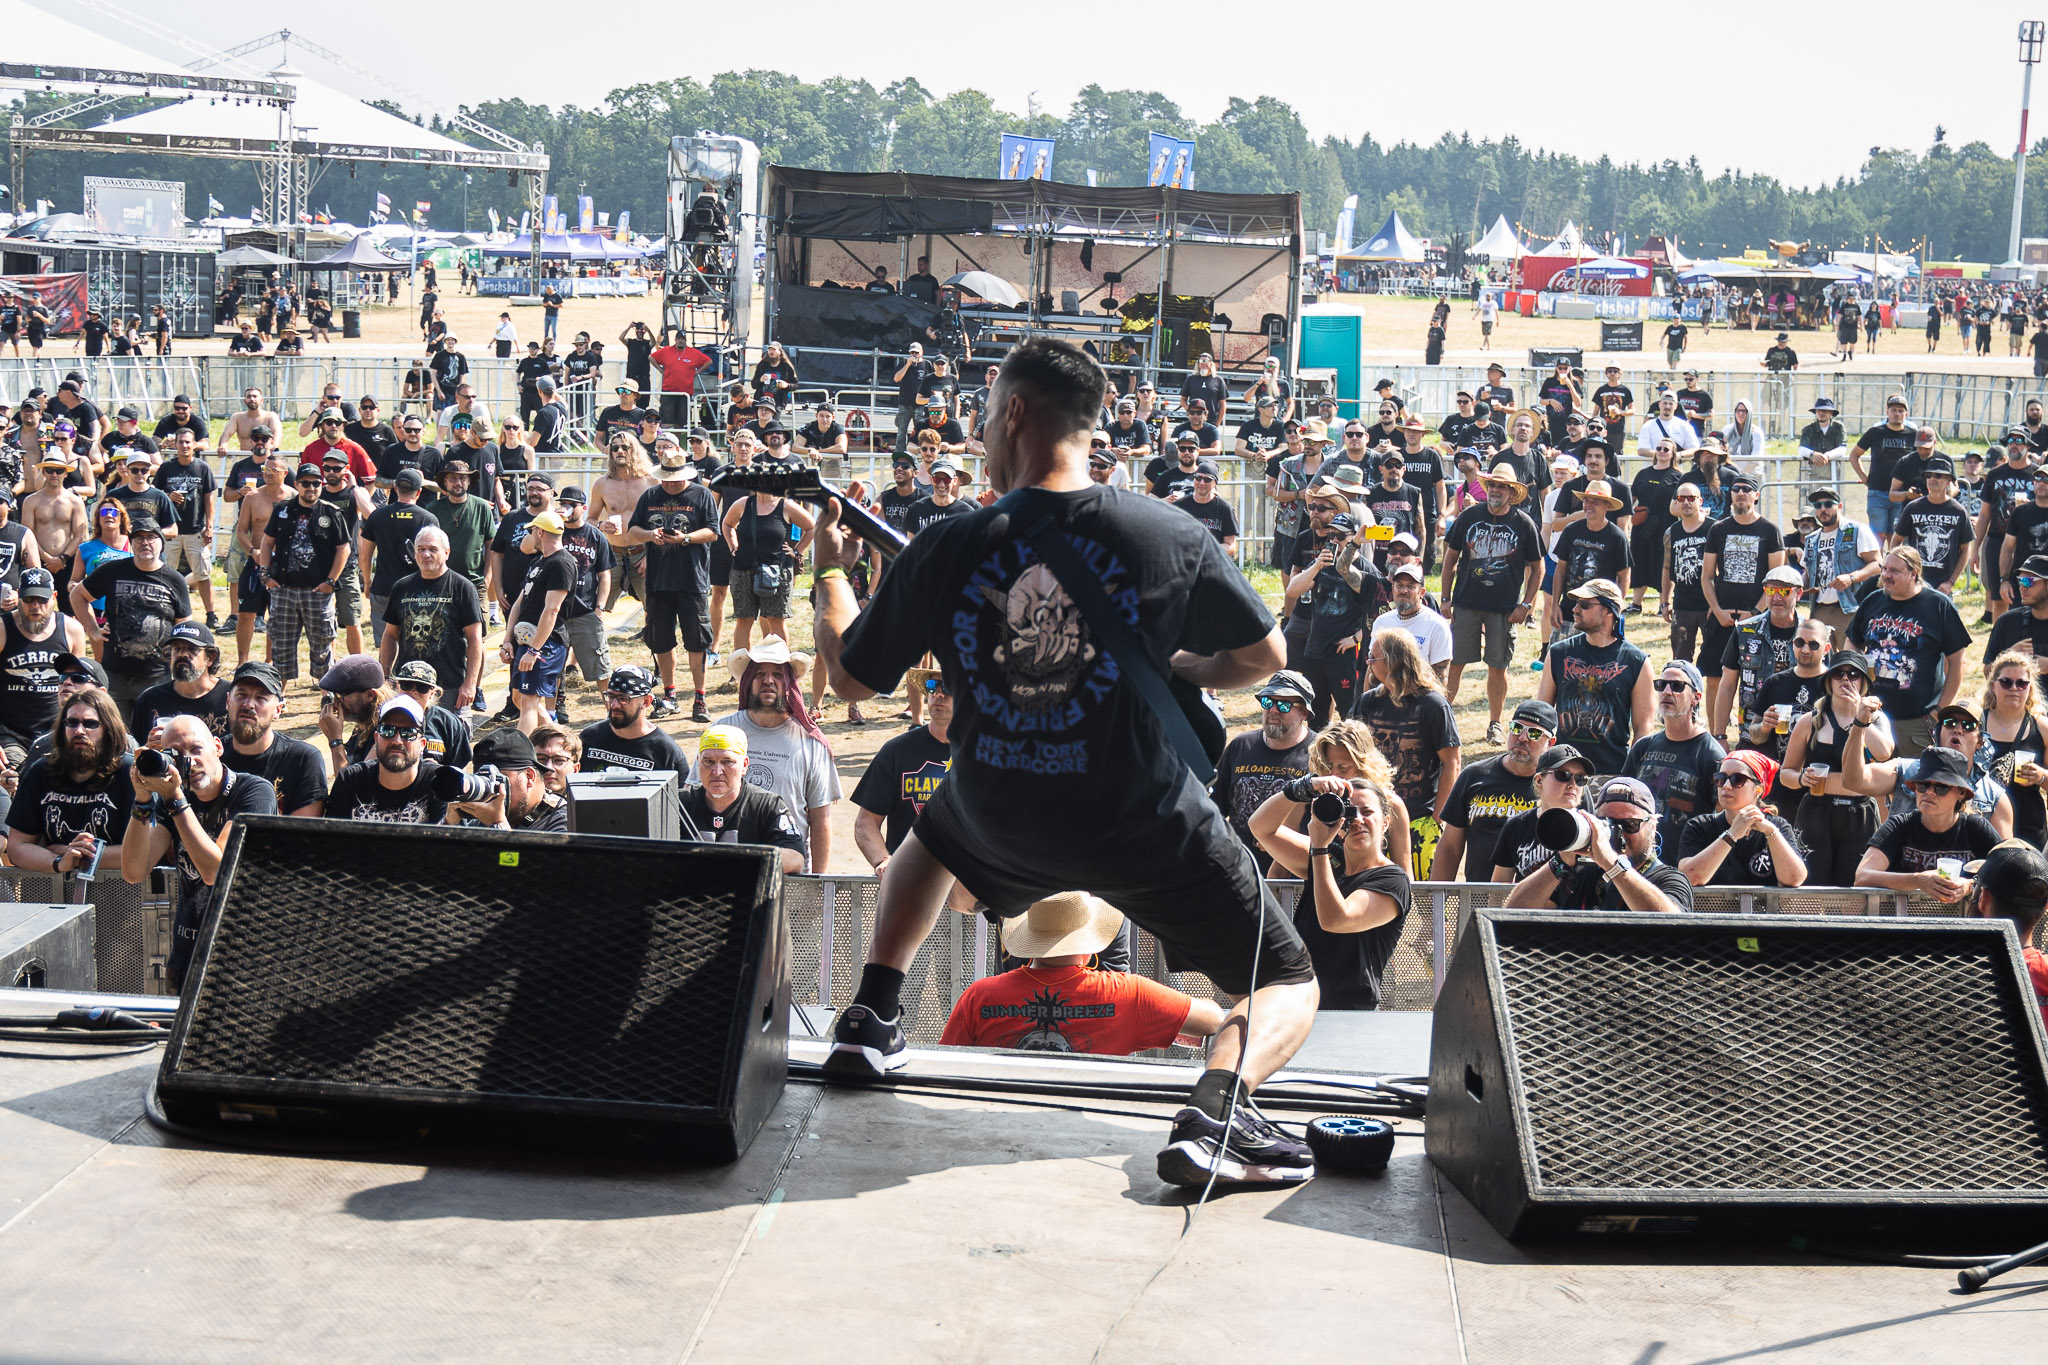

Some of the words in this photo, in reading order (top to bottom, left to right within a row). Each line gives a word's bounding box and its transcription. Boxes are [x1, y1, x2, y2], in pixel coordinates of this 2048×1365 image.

[1403, 462, 1432, 474] OWBAR
[1911, 514, 1960, 526] WACKEN
[962, 552, 1007, 607] MY
[952, 611, 979, 671] FOR
[7, 651, 58, 668] TERRO
[8, 684, 24, 692] LIFE
[971, 682, 1087, 733] FRIENDS
[976, 733, 1028, 753] NEW
[1034, 739, 1088, 756] YORK
[589, 749, 652, 769] EYEHATEGOD
[763, 752, 790, 760] University
[976, 748, 1089, 774] HARDCORE
[1641, 751, 1677, 763] REFUSED
[41, 792, 118, 810] MEOWTALLICA
[503, 853, 514, 864] 3
[980, 1004, 1049, 1019] SUMMER
[1052, 1003, 1116, 1019] BREEZE
